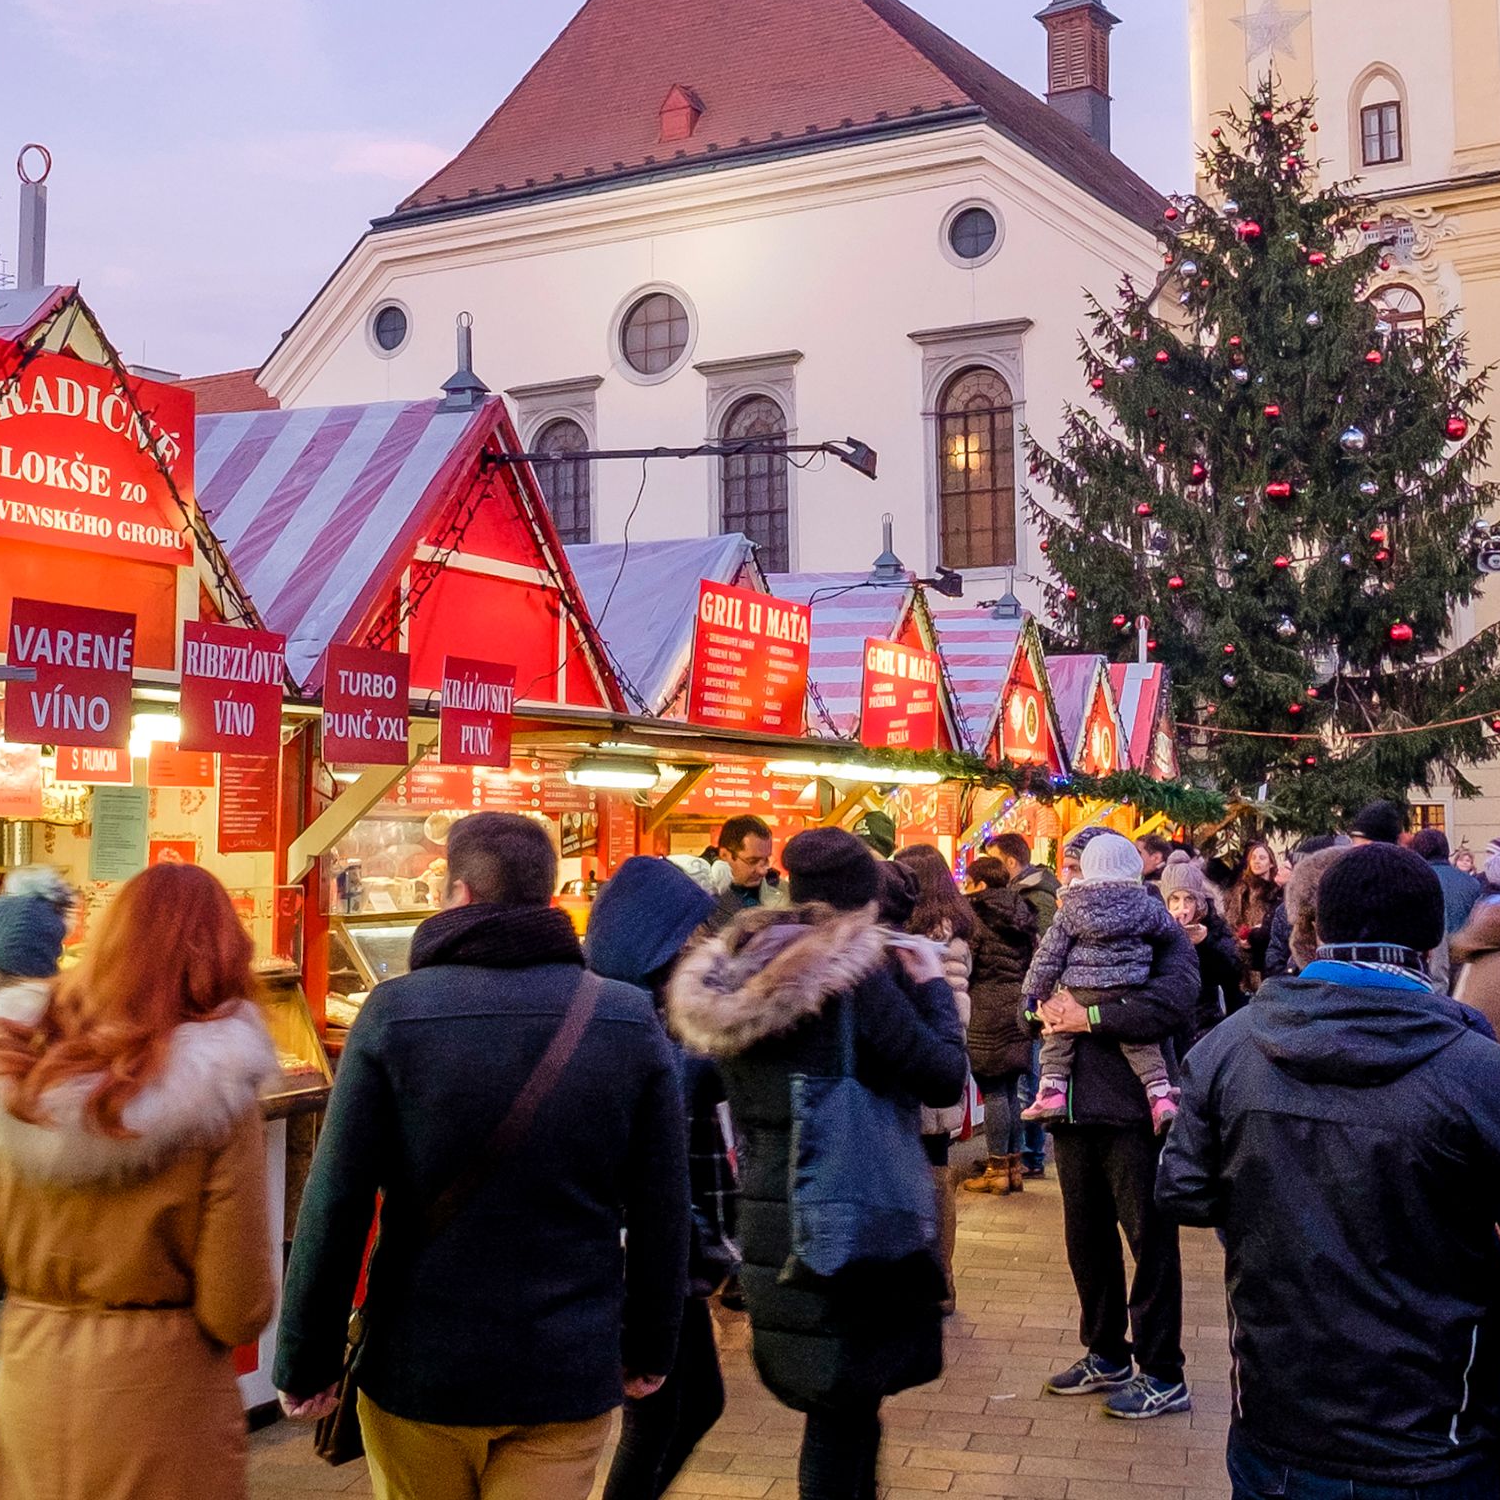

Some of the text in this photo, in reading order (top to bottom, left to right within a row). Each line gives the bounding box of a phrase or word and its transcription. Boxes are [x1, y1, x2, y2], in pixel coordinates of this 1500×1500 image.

[0, 445, 111, 497] LOKŠE
[117, 520, 186, 550] GROBU
[700, 591, 743, 631] GRIL
[766, 606, 808, 645] MAŤA
[13, 624, 132, 672] VARENÉ
[185, 631, 284, 686] RÍBEZĽOVÉ
[867, 646, 895, 676] GRIL
[908, 654, 937, 684] MAŤA
[338, 669, 396, 699] TURBO
[442, 671, 514, 715] KRÁĽOVSKÝ
[30, 684, 110, 732] VÍNO
[213, 690, 255, 737] VÍNO
[324, 708, 408, 742] PUNČ XXL
[461, 718, 493, 756] PUNČ
[71, 748, 118, 773] S RUMOM
